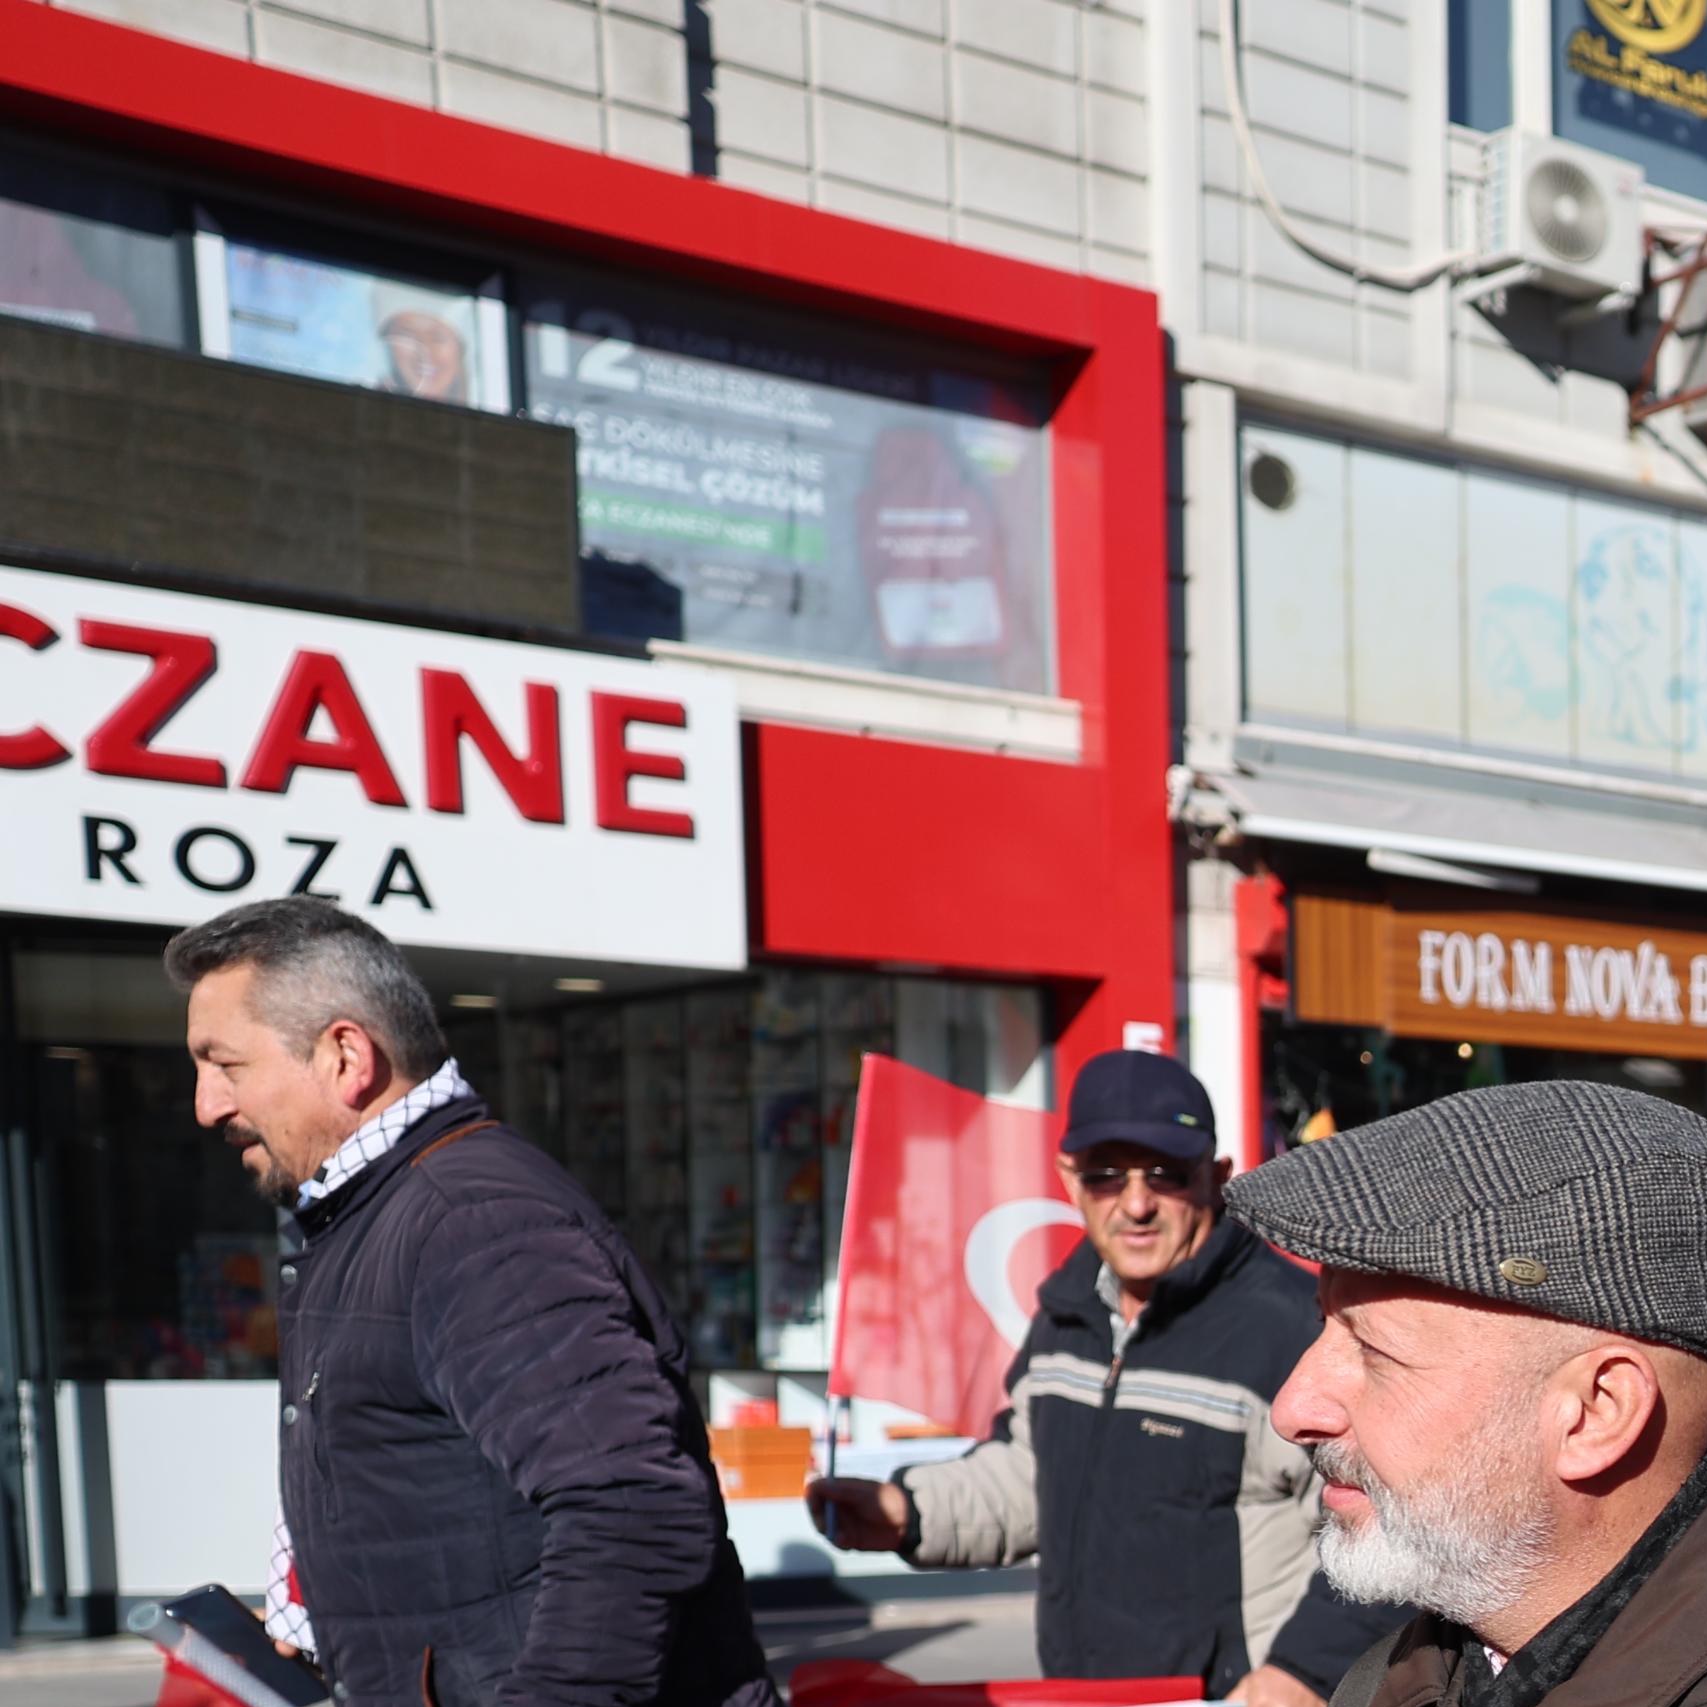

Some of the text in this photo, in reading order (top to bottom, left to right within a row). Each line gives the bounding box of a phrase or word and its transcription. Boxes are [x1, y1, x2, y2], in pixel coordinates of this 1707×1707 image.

[528, 303, 641, 393] 12
[701, 465, 825, 517] ÇÖZÜM
[82, 815, 435, 911] ROZA
